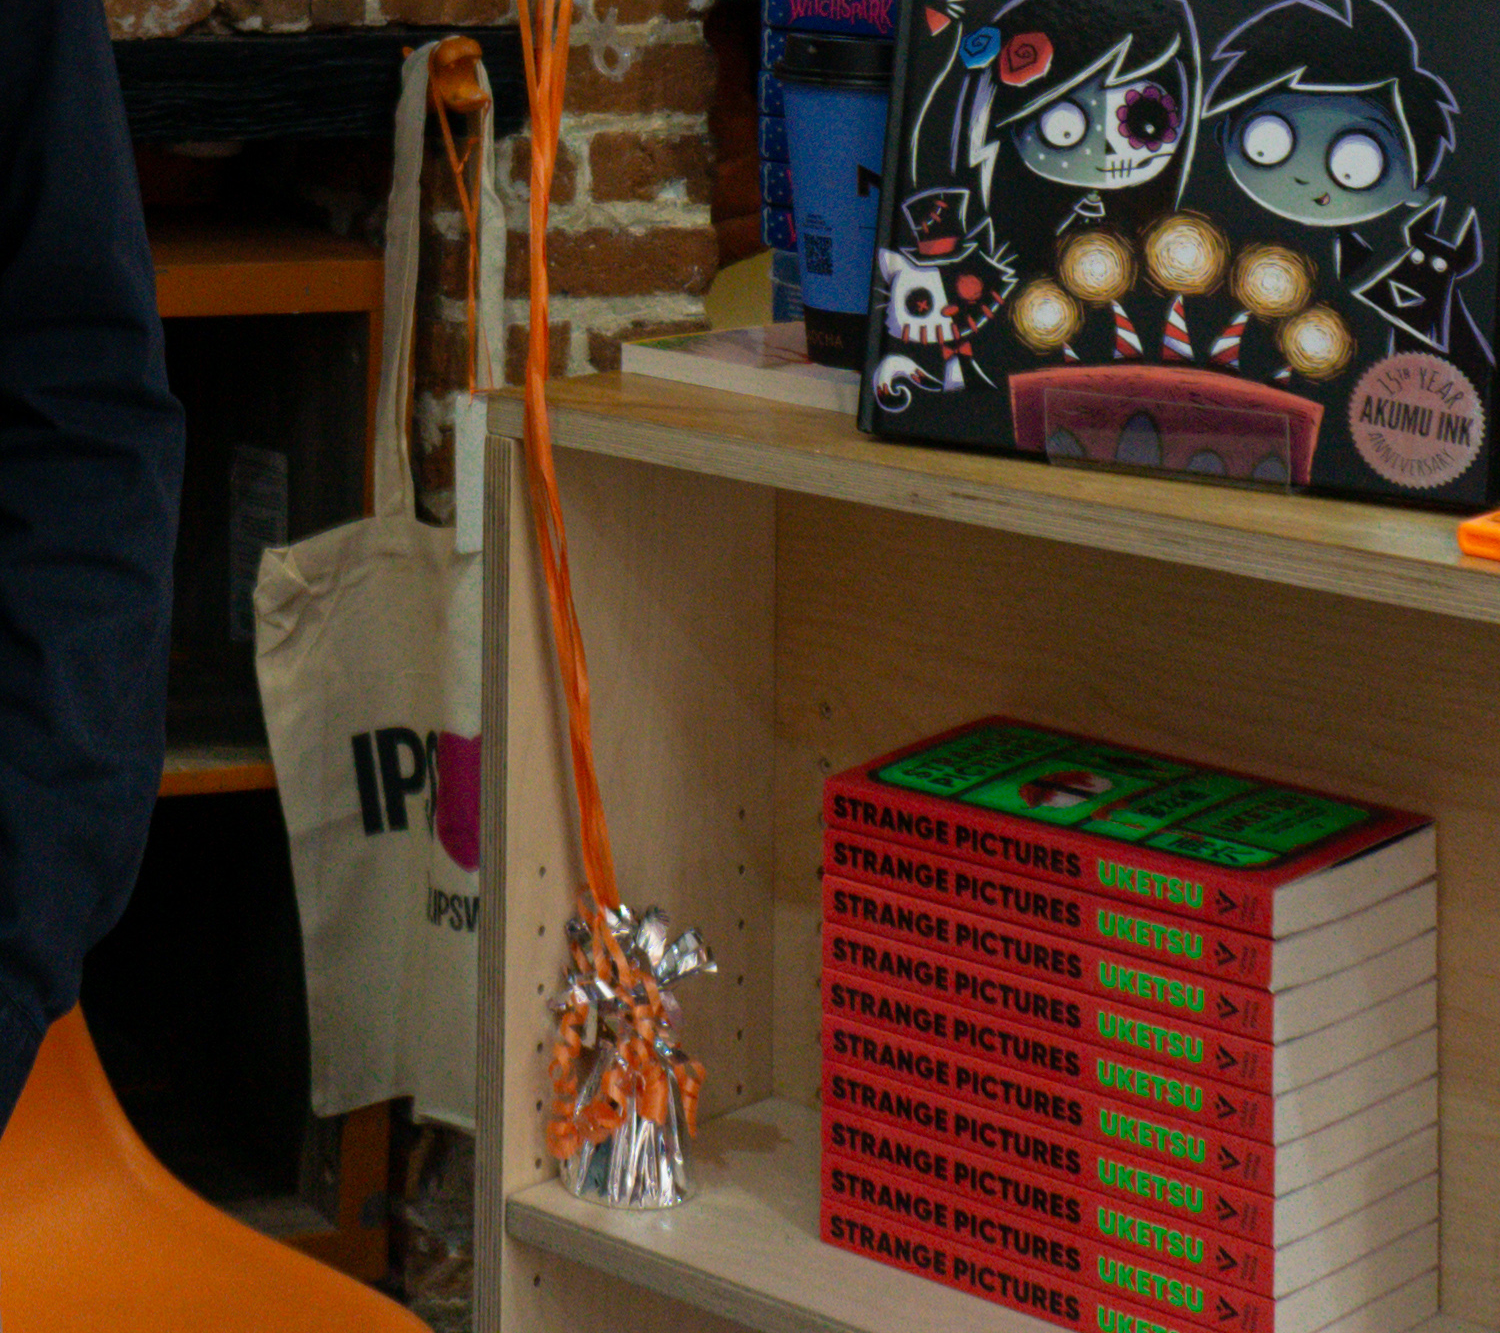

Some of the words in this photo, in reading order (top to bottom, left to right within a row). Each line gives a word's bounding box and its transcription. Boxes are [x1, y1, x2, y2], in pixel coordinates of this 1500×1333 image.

[1360, 395, 1433, 437] AKUMU
[1437, 411, 1474, 447] INK
[1419, 367, 1464, 409] YEAR
[832, 793, 949, 846] STRANGE
[954, 824, 1082, 879] PICTURES
[1098, 859, 1204, 909] UKETSU
[832, 841, 949, 894] STRANGE
[954, 872, 1082, 928] PICTURES
[1098, 910, 1204, 960] UKETSU
[832, 890, 949, 944] STRANGE
[954, 923, 1082, 980] PICTURES
[1098, 961, 1204, 1013] UKETSU
